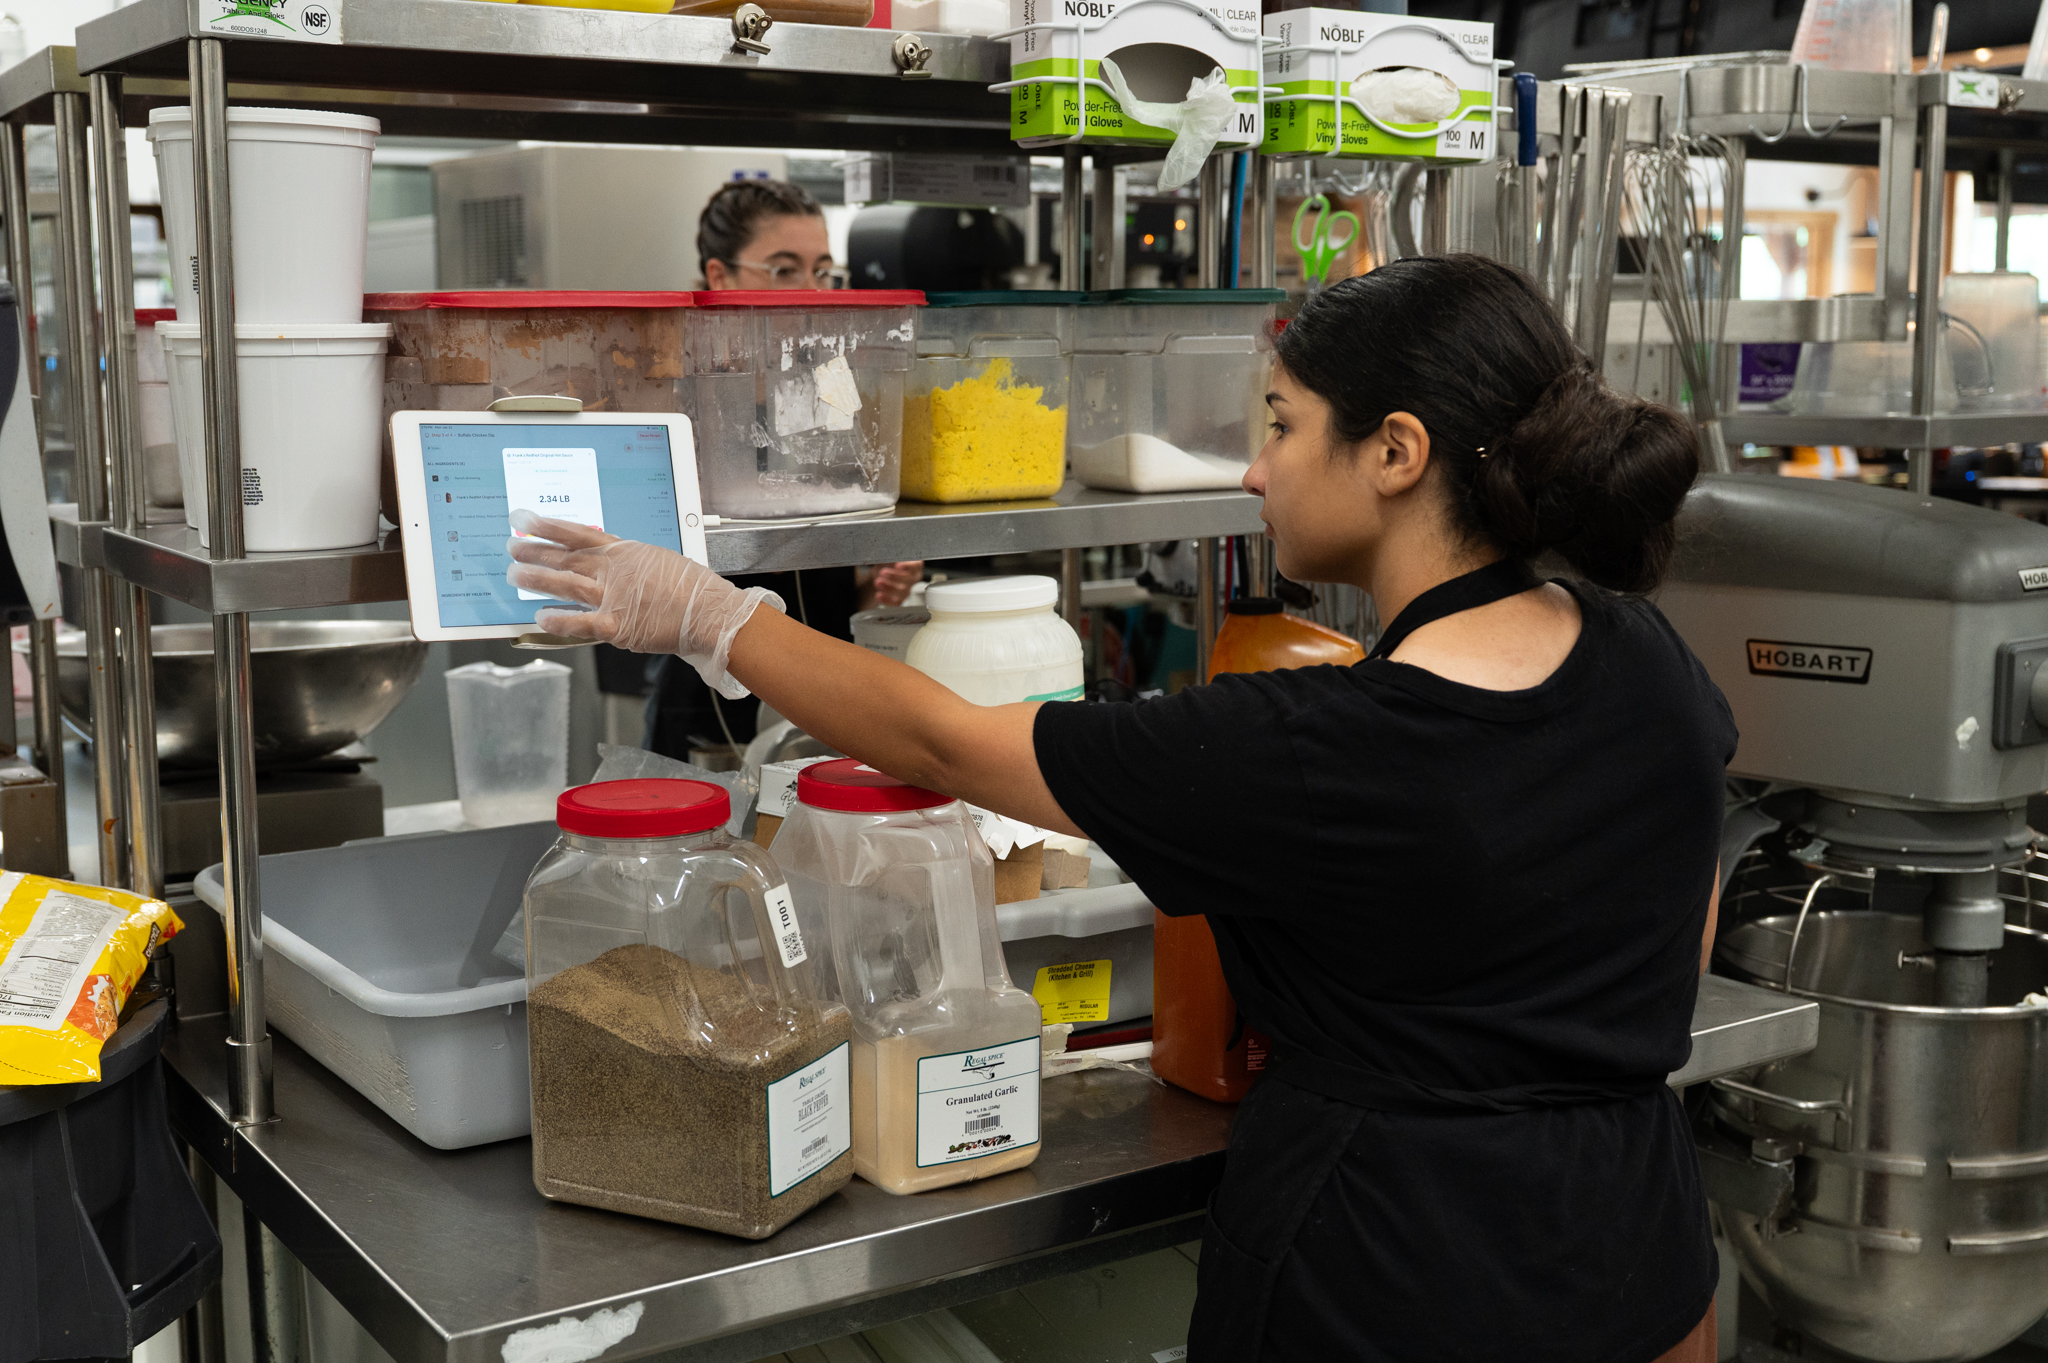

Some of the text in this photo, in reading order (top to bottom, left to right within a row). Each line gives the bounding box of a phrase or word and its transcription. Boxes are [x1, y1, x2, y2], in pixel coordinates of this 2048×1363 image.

[222, 7, 245, 15] Tables
[265, 12, 285, 20] Sinks
[1226, 9, 1257, 21] CLEAR
[1462, 34, 1489, 45] CLEAR
[1063, 114, 1123, 128] Vinl Gloves
[1239, 112, 1255, 133] M
[1316, 118, 1370, 131] Power-Free
[1315, 132, 1369, 146] Viny Gloves
[1446, 130, 1461, 141] 100
[1470, 131, 1485, 150] M
[539, 495, 570, 503] 2.34 LB
[2024, 572, 2048, 586] HOB
[1756, 649, 1861, 672] HOBART
[777, 899, 791, 930] T001
[1047, 963, 1095, 974] Shredded Cheese
[1048, 973, 1072, 983] (Kitchen
[1078, 970, 1094, 978] Grill)
[14, 1011, 51, 1019] Nutrition
[963, 1052, 1004, 1067] REGAL SPICE
[946, 1085, 1019, 1107] Granulated Garlic
[798, 1093, 829, 1121] BLACK PEPPER
